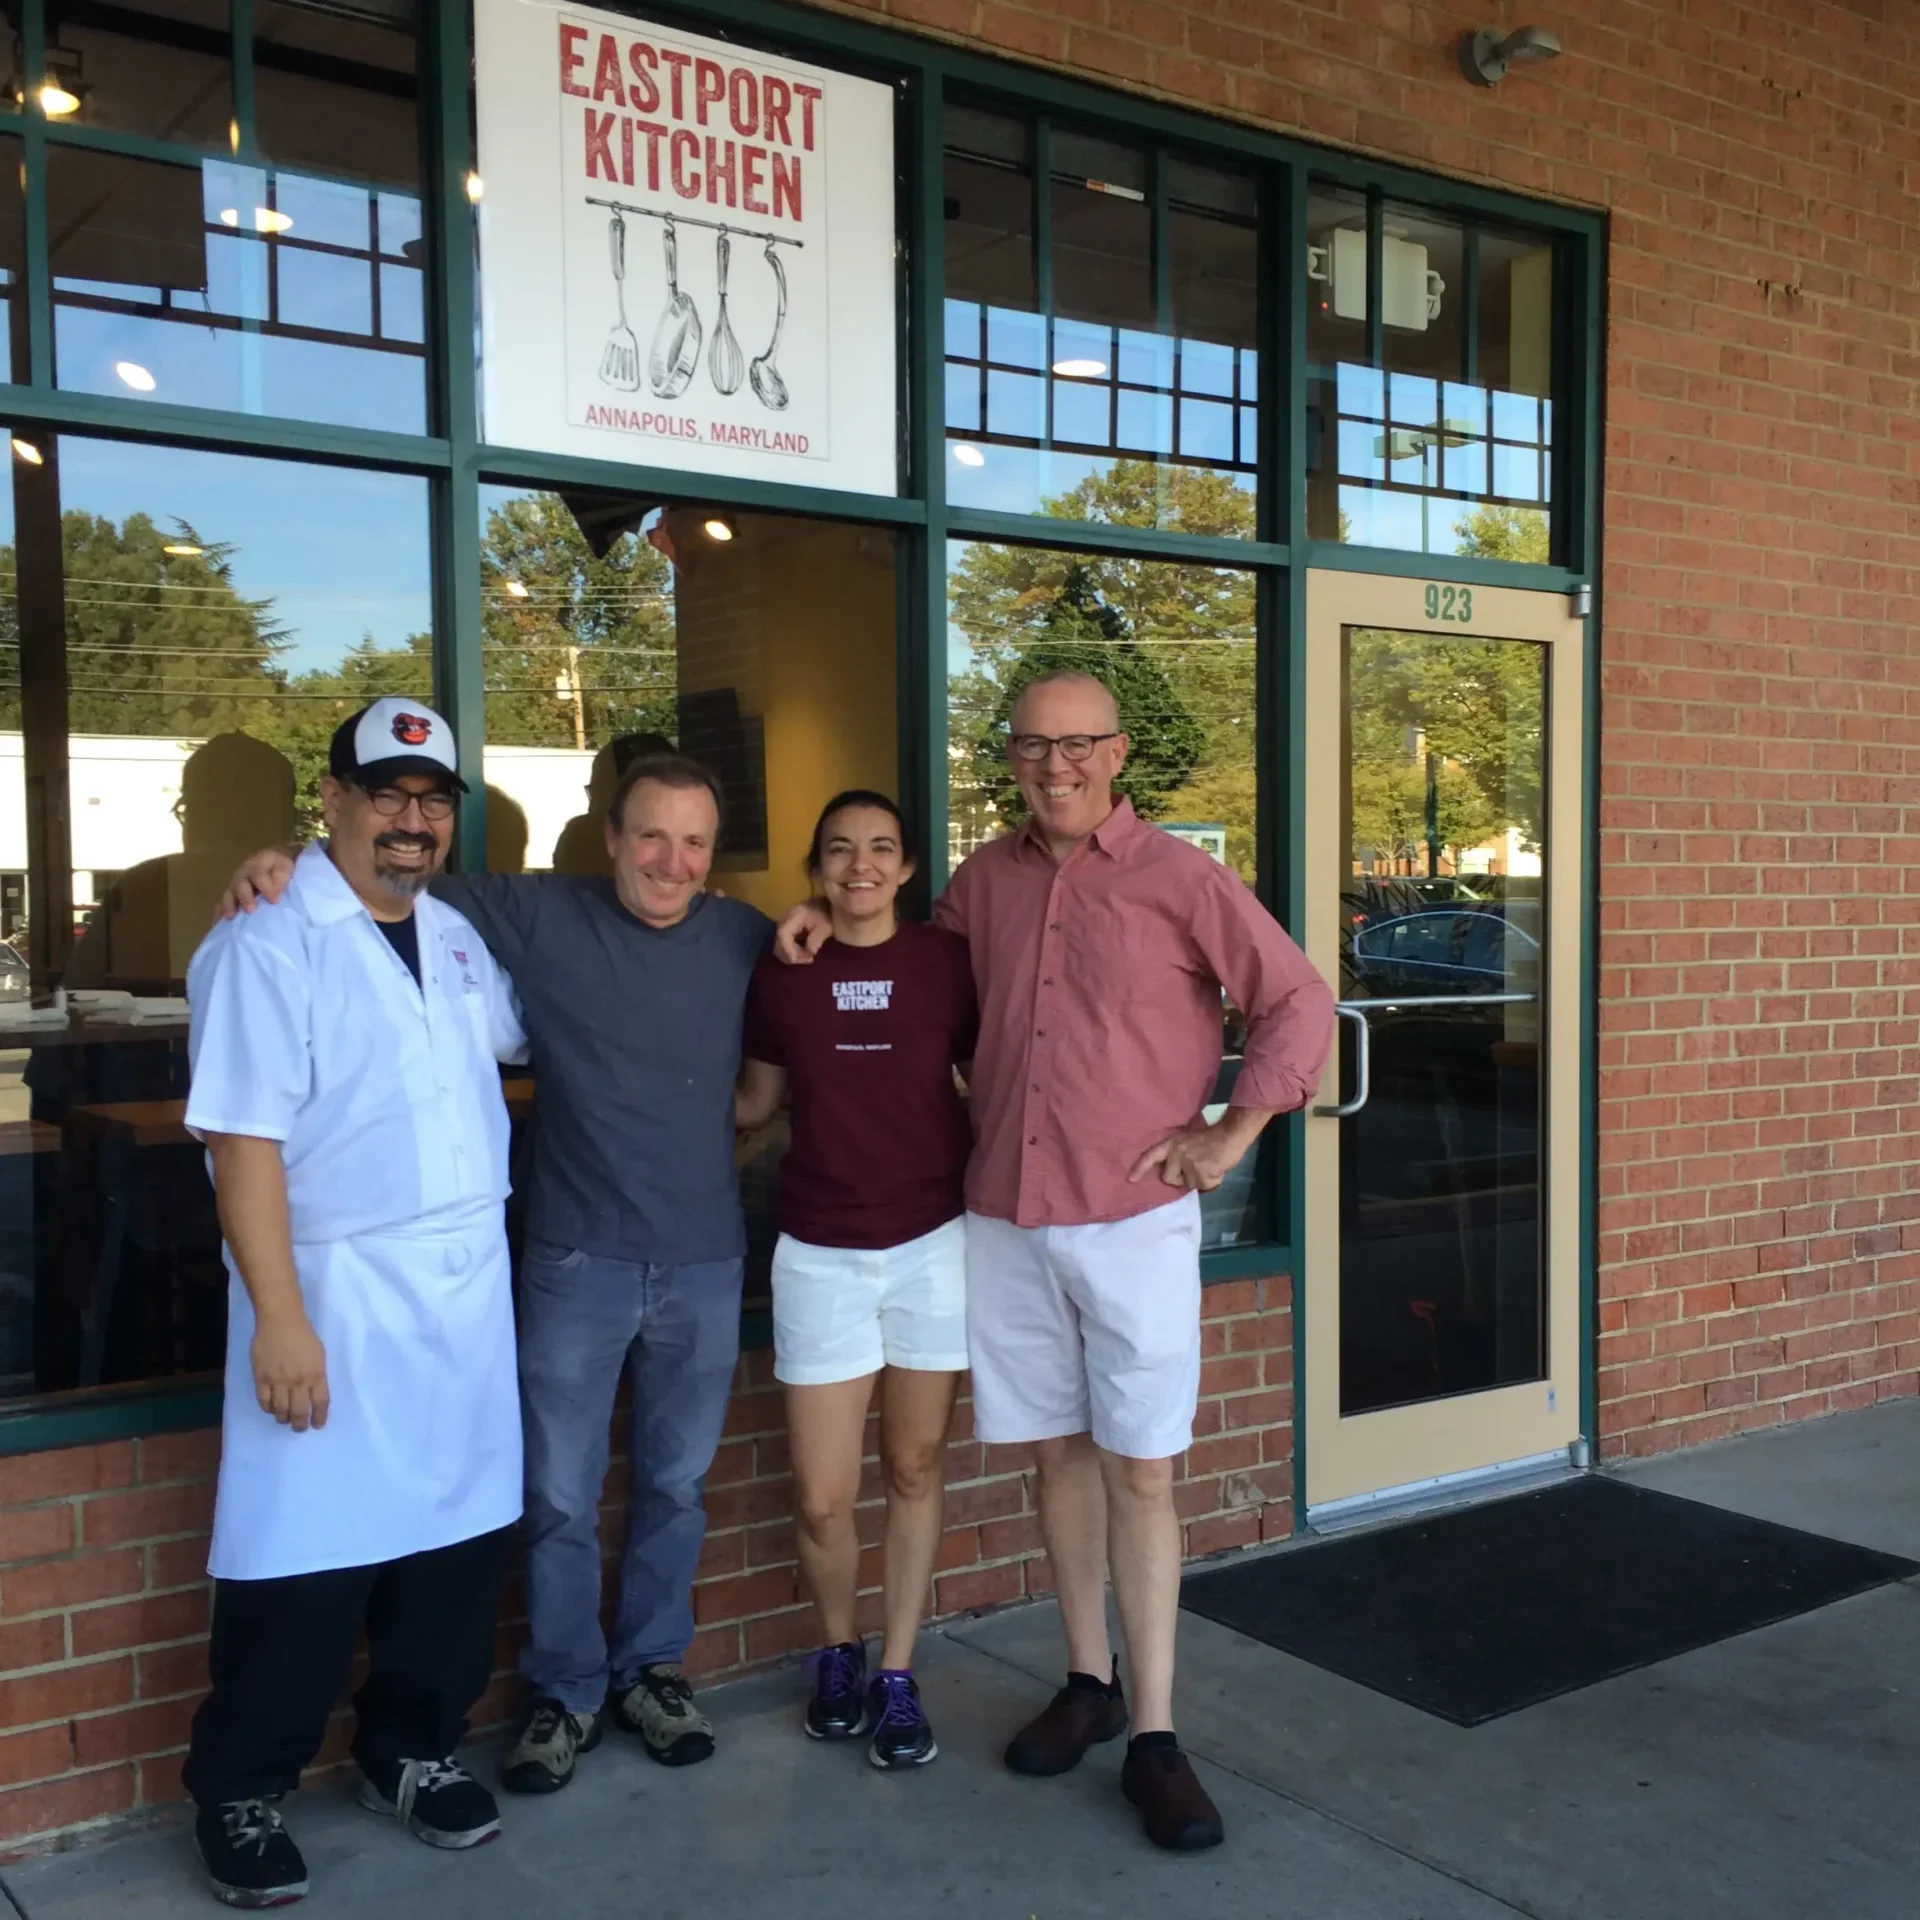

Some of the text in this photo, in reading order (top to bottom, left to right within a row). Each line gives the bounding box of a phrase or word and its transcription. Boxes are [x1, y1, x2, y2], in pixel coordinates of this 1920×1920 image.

[559, 22, 822, 152] EASTPORT
[584, 107, 802, 223] KITCHEN
[585, 404, 809, 454] ANNAPOLIS, MARYLAND
[1424, 583, 1472, 623] 923
[832, 980, 894, 997] EASTPORT
[837, 995, 889, 1010] KITCHEN
